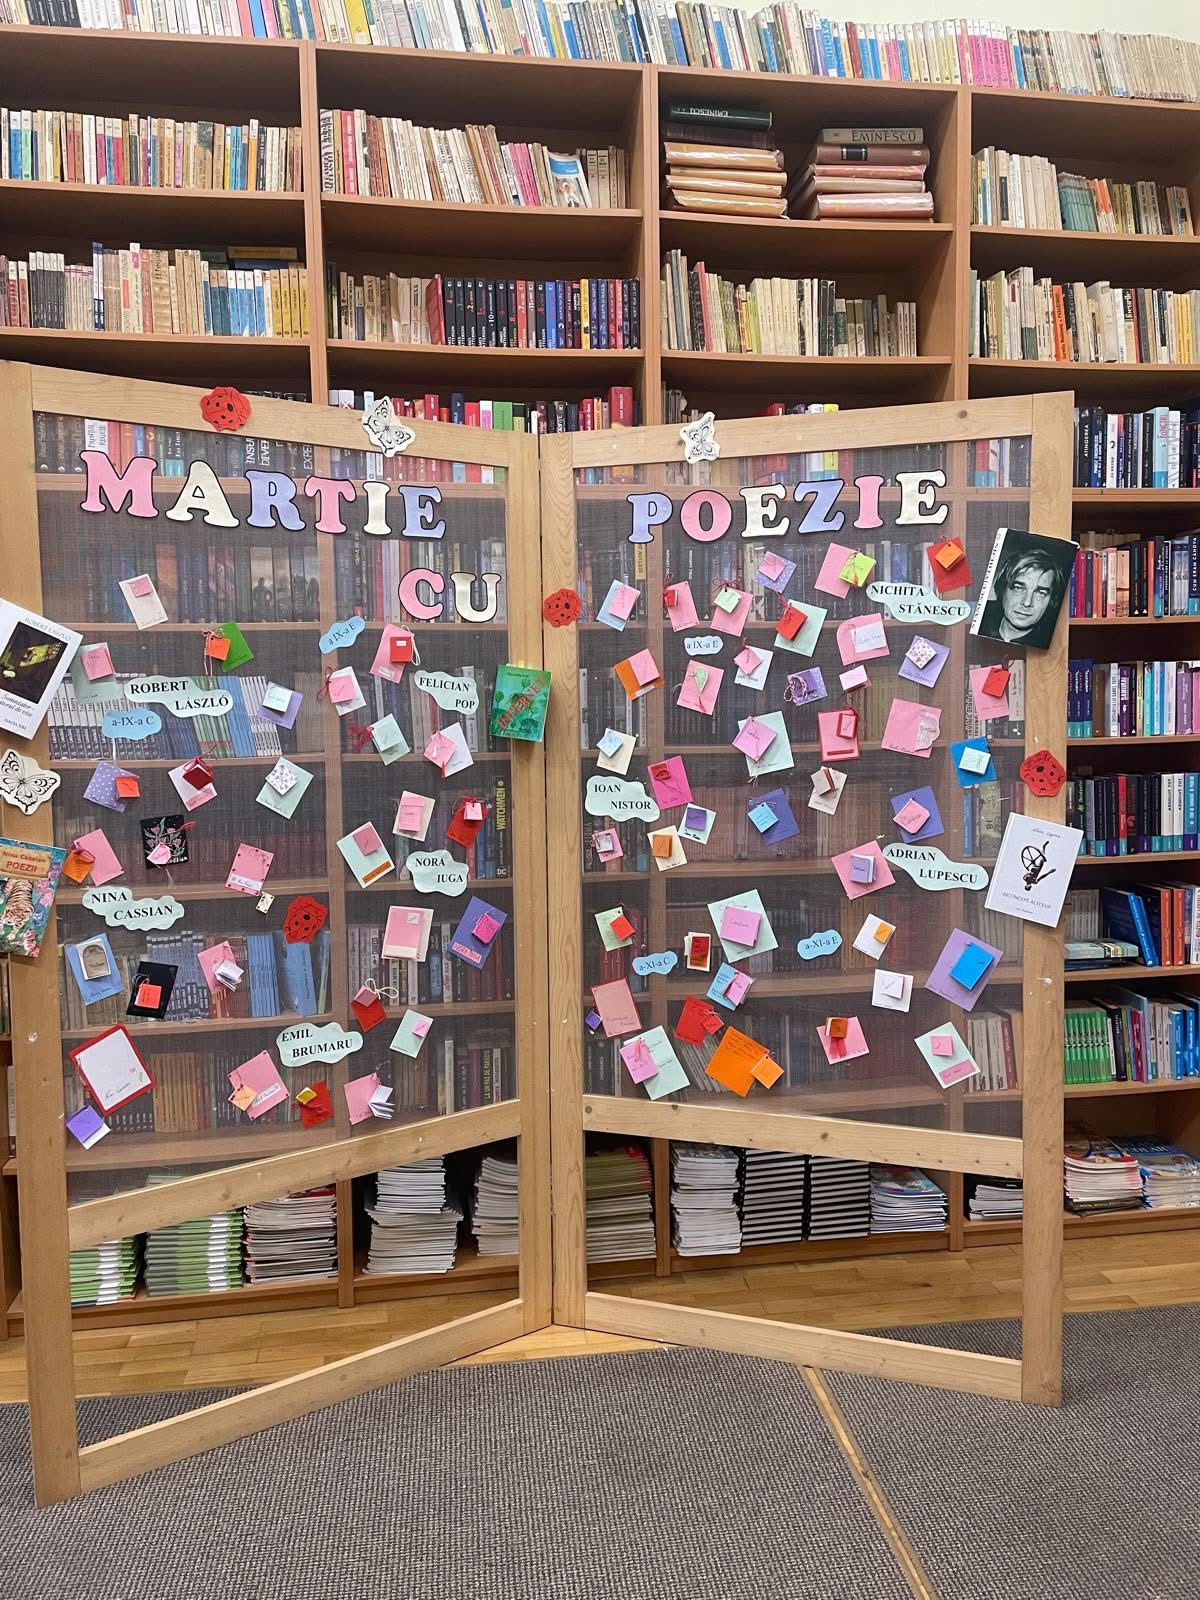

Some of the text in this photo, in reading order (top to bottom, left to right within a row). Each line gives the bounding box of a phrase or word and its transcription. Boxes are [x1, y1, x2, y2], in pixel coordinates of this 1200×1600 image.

[851, 131, 916, 143] EMINESCU
[80, 450, 446, 539] MARTIE
[626, 469, 950, 544] POEZIE
[398, 567, 502, 623] CU
[871, 585, 925, 597] NICHITA
[899, 602, 967, 617] STĂNESCU
[327, 623, 357, 646] a IX-a E
[693, 639, 711, 649] IX-a
[712, 640, 719, 648] E
[130, 680, 189, 695] ROBERT
[419, 677, 470, 692] FELICIAN
[175, 695, 230, 711] LÁSZLÓ
[455, 699, 476, 710] POP
[111, 715, 155, 726] a-IX-a C
[594, 784, 621, 793] IOAN
[496, 786, 506, 831] WATCHMEN
[610, 800, 651, 810] NISTOR
[415, 857, 445, 866] NORA
[886, 848, 937, 861] ADRIAN
[6, 860, 38, 872] POEZII
[437, 874, 463, 883] IUGA
[919, 868, 978, 884] LUPESCU
[91, 891, 128, 904] NINA
[113, 905, 174, 920] CASSIAN
[805, 936, 839, 950] a-XI-a E
[639, 956, 671, 972] a-XI-a C
[281, 1029, 313, 1042] EMIL
[292, 1038, 354, 1058] BRUMARU
